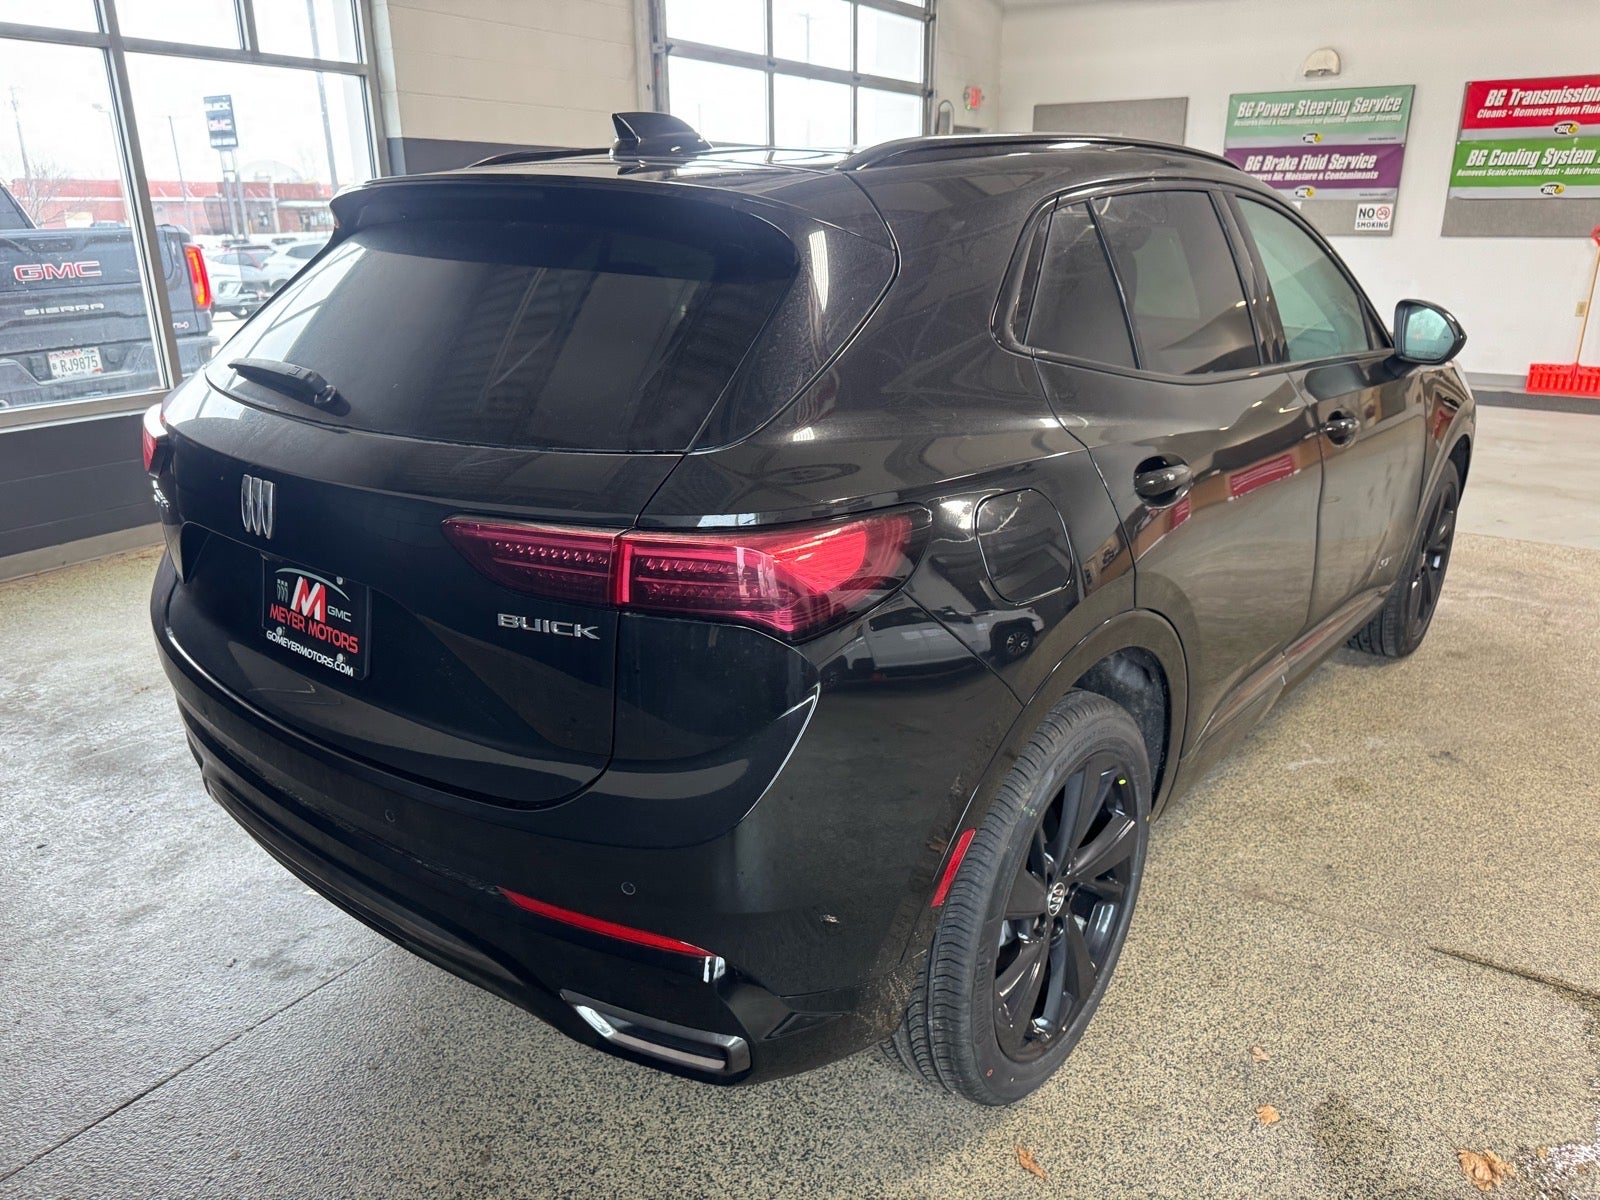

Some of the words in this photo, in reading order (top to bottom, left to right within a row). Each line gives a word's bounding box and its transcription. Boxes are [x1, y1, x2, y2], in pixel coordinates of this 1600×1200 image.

[1484, 89, 1507, 107] BG
[1508, 84, 1600, 106] Transmission
[1237, 101, 1255, 118] BG
[1255, 101, 1295, 118] Power
[1295, 98, 1351, 117] Steering
[1352, 95, 1402, 114] Service
[1477, 108, 1507, 118] Cleans
[1513, 107, 1555, 117] Removes
[1555, 105, 1580, 116] Worn
[1244, 155, 1263, 171] BG
[1262, 154, 1299, 171] Brake
[1299, 154, 1330, 170] Fluid
[1328, 152, 1377, 170] Service
[1465, 149, 1488, 167] BG
[1488, 148, 1541, 168] Cooling
[1541, 147, 1597, 168] System
[1284, 171, 1318, 180] Moisture
[1324, 170, 1379, 180] Contaminants
[1358, 207, 1375, 218] NO
[13, 261, 102, 281] GMC
[24, 303, 104, 316] SIERRA
[60, 355, 98, 373] RJ9875
[327, 605, 352, 622] GMC
[269, 603, 306, 633] MEYER
[307, 620, 359, 654] MOTORS
[497, 613, 600, 640] BUICK
[266, 630, 354, 677] GOMEYERMOTORS.COM
